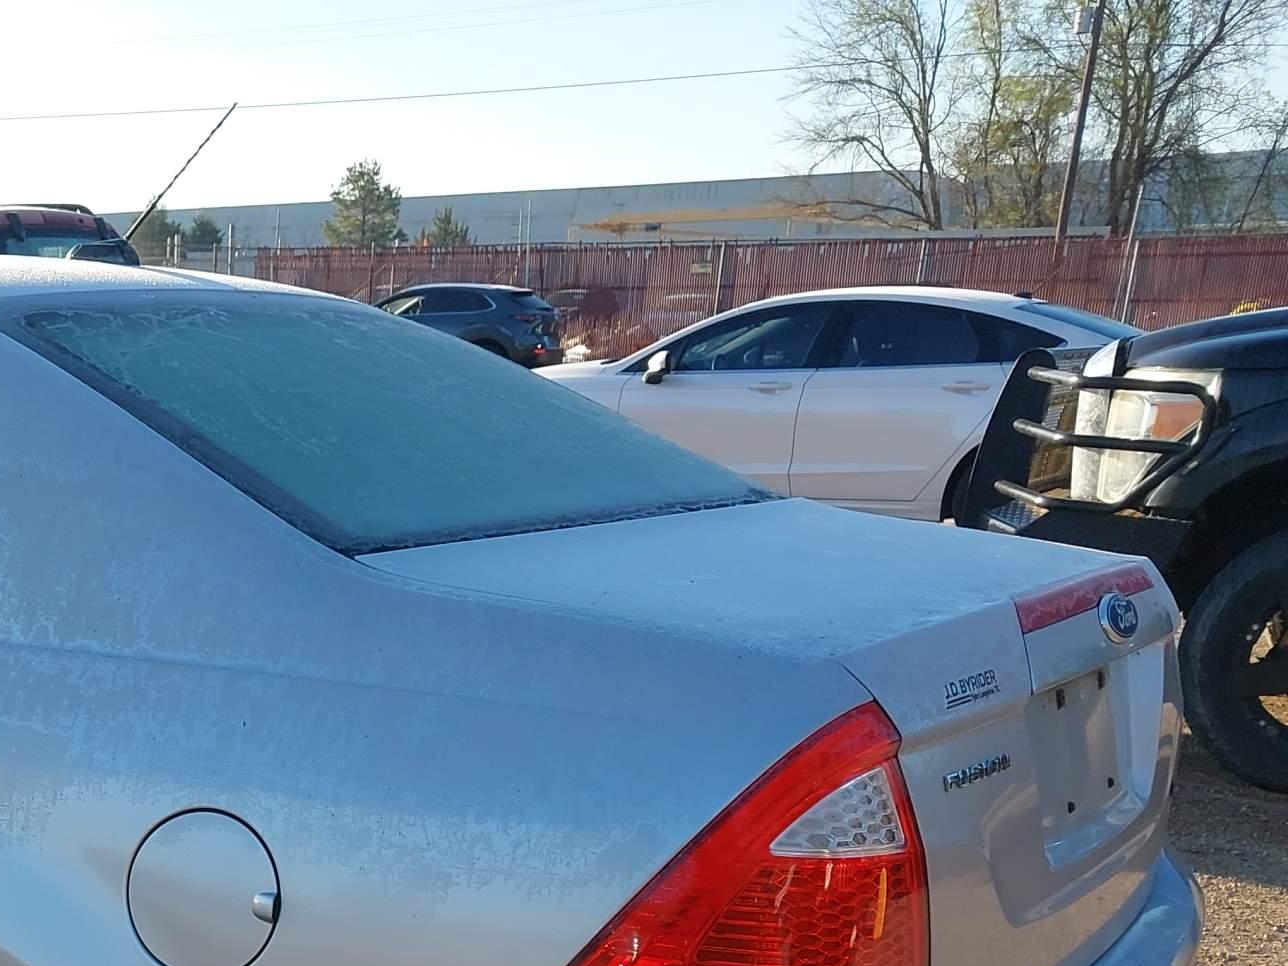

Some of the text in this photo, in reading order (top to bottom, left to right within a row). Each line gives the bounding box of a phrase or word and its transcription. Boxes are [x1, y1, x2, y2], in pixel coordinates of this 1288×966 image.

[1115, 600, 1137, 630] Ford
[958, 669, 997, 694] BYRIDER
[943, 753, 1012, 792] FUSION
